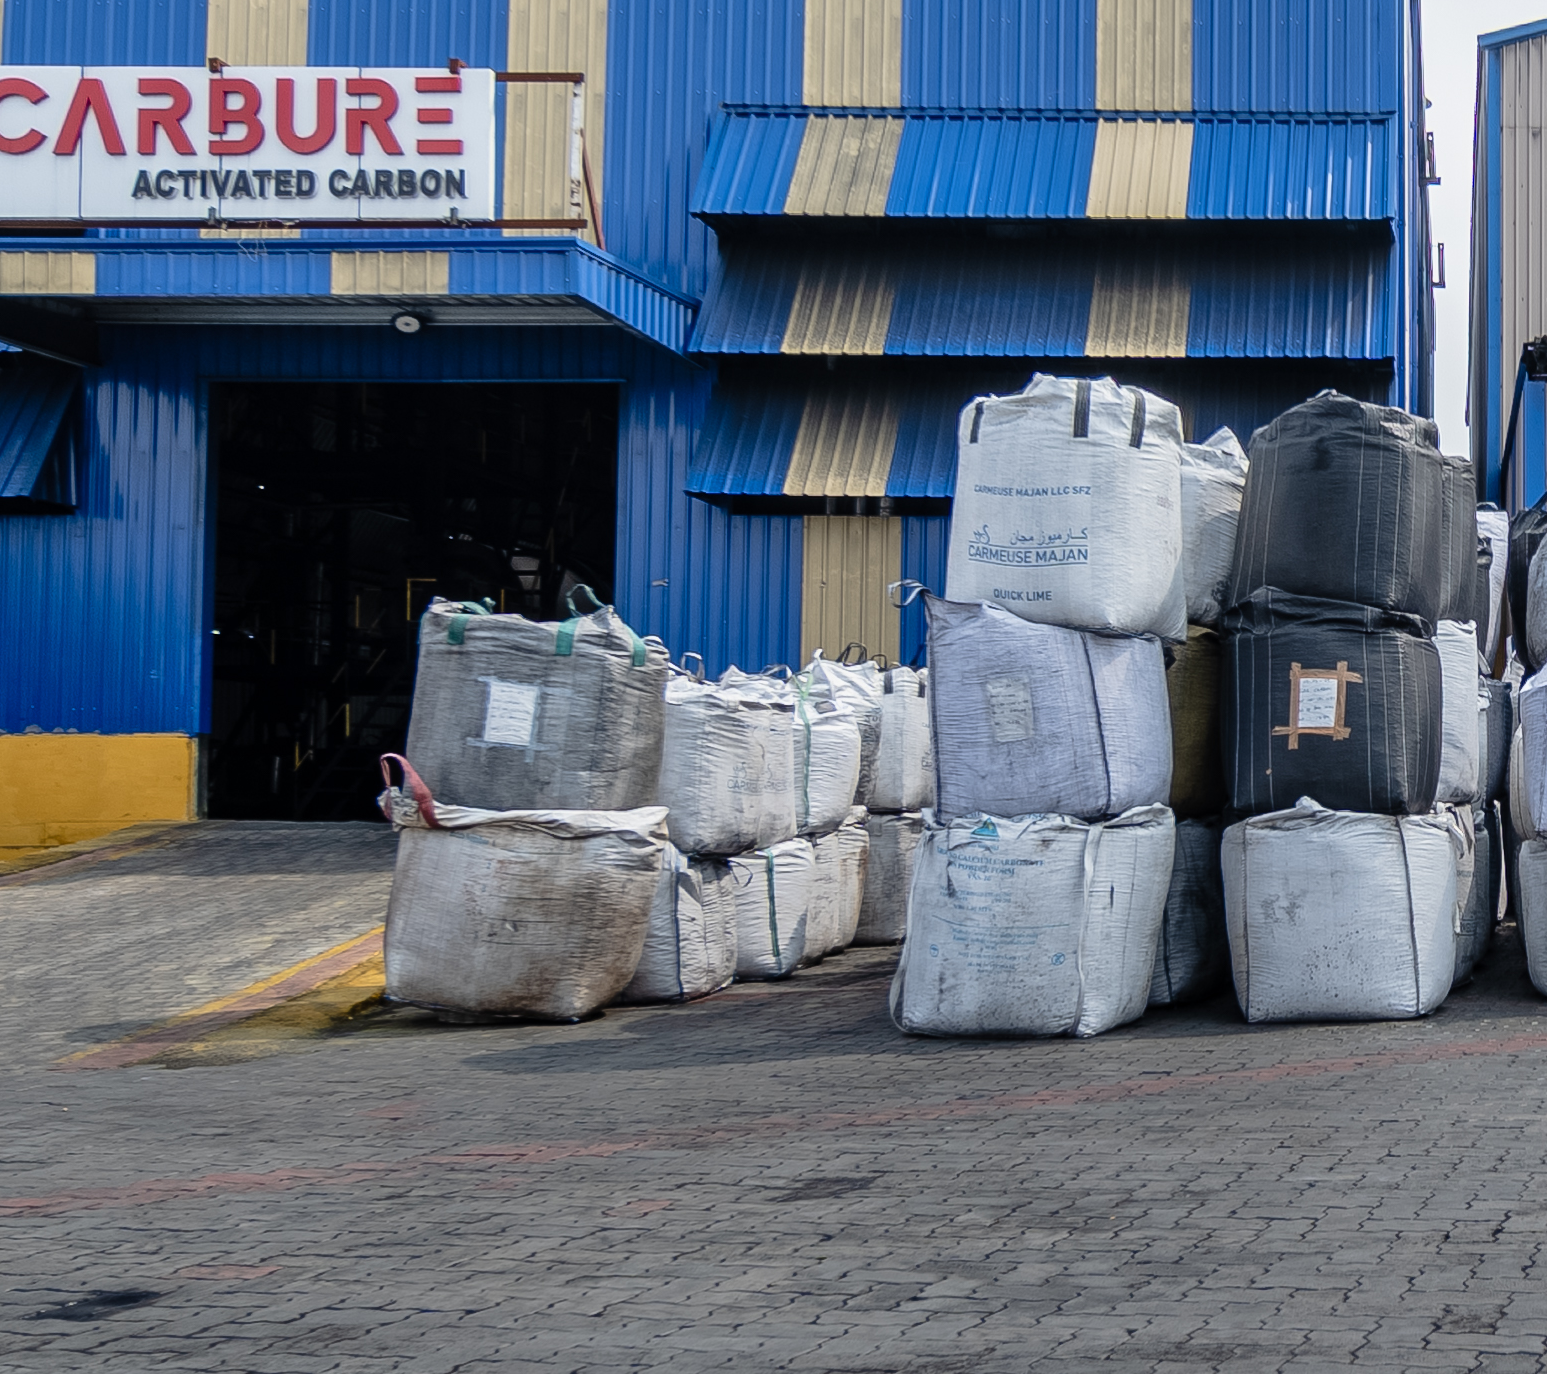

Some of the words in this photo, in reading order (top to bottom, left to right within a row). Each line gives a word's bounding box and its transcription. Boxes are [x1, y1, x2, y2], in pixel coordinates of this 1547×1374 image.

[131, 169, 318, 199] ACTIVATED
[329, 168, 468, 199] CARBON
[974, 484, 1014, 497] CARMEUSE
[1015, 487, 1049, 497] MAJAN
[1051, 486, 1070, 496] LLC
[1072, 486, 1091, 495] SFZ
[968, 545, 1032, 563] CARMEUSE
[1035, 548, 1088, 563] MAJAN
[993, 588, 1024, 601] QUICK
[1026, 591, 1052, 601] LIME
